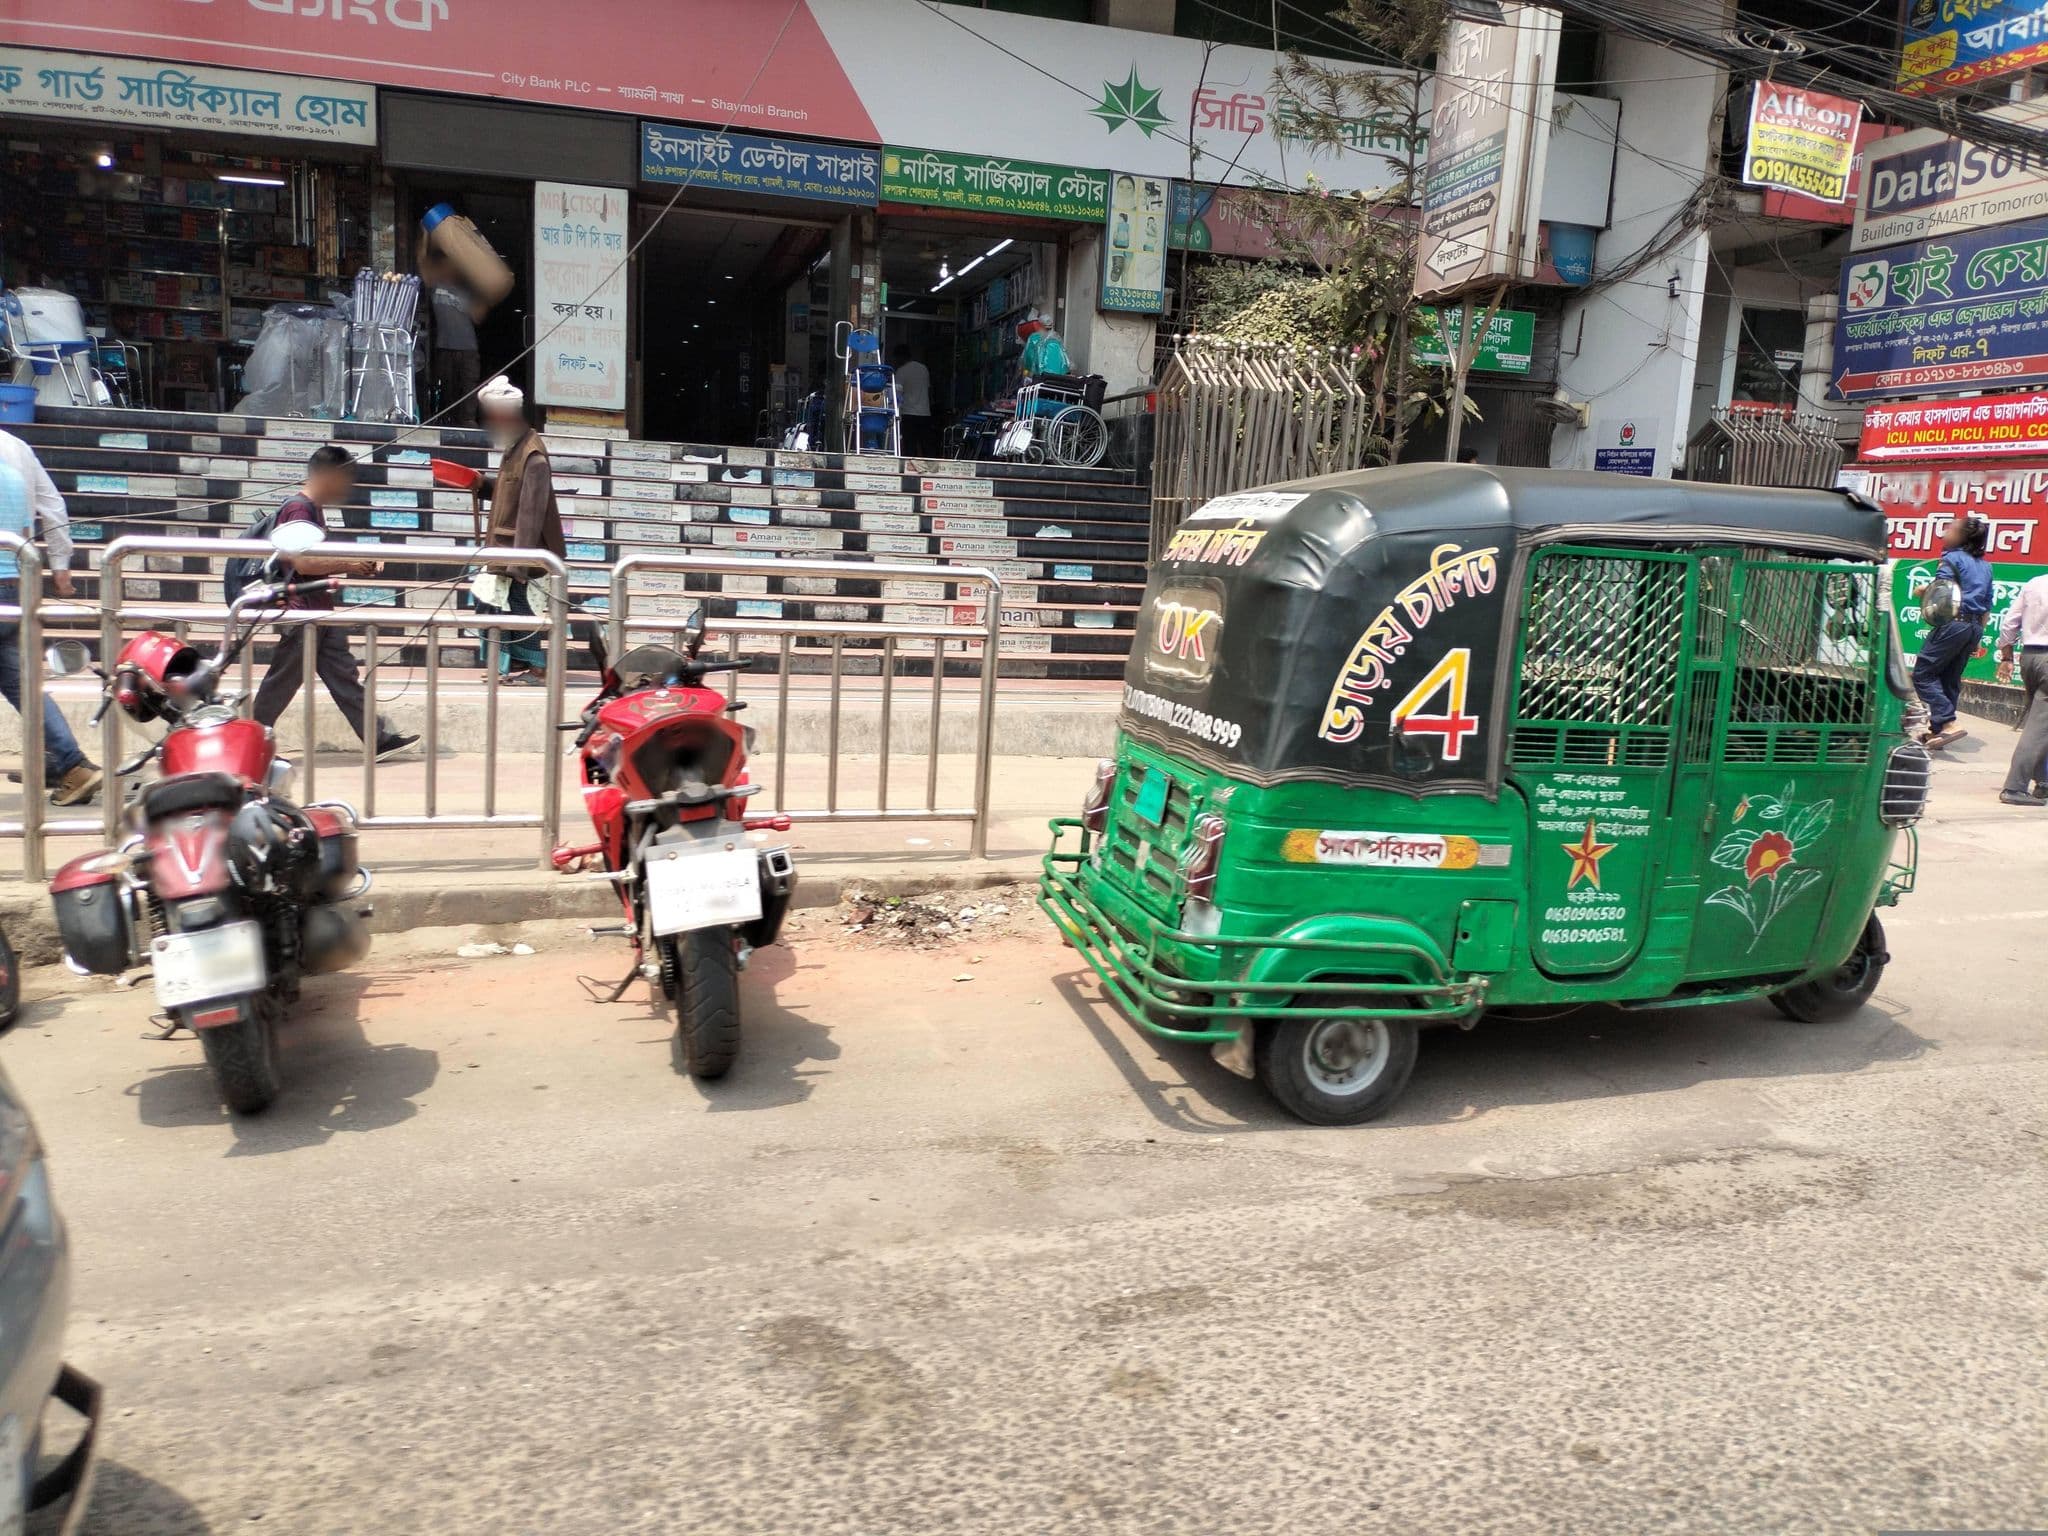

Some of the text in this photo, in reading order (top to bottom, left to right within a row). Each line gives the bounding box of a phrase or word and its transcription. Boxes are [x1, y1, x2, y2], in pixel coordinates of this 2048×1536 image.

[501, 72, 591, 93] City Bank PLC
[38, 66, 105, 101] গার্ড
[117, 69, 281, 119] সার্জিক্যাল
[296, 95, 368, 127] হোম
[618, 86, 684, 105] শ্যামলী শাখা
[711, 98, 808, 121] Shaymoli Branch
[1762, 93, 1851, 129] Alicon
[1759, 113, 1847, 140] Network
[647, 128, 878, 185] ইনসাইট ডেন্টাল সাপ্লাই
[902, 153, 1107, 202] নাসির সার্জিক্যাল স্টোর
[1752, 158, 1843, 198] 01914555421
[1862, 219, 1913, 242] Building
[1918, 219, 1924, 230] a
[1928, 203, 1978, 228] SMART
[562, 223, 574, 245] টি
[590, 226, 601, 248] সি
[1890, 244, 1958, 304] হাই
[552, 302, 579, 318] করা
[1894, 408, 1921, 427] কেয়ার
[1924, 406, 1971, 425] হাসপাতাল
[1973, 404, 1992, 421] এন্ড
[1887, 432, 1910, 445] ICU,
[1913, 429, 1948, 443] NICU,
[1951, 427, 1986, 441] PICU,
[1989, 425, 2023, 440] HDU,
[935, 482, 963, 490] Amana
[939, 500, 968, 508] Amana
[750, 532, 782, 541] Amana
[947, 521, 976, 529] Amana
[955, 542, 985, 550] Amana
[1158, 602, 1210, 661] OK
[1318, 543, 1499, 743] ভাড়ায় চালিত
[1389, 648, 1479, 760] 4
[1368, 836, 1443, 864] পরিবহন
[1545, 906, 1626, 922] 01680906580
